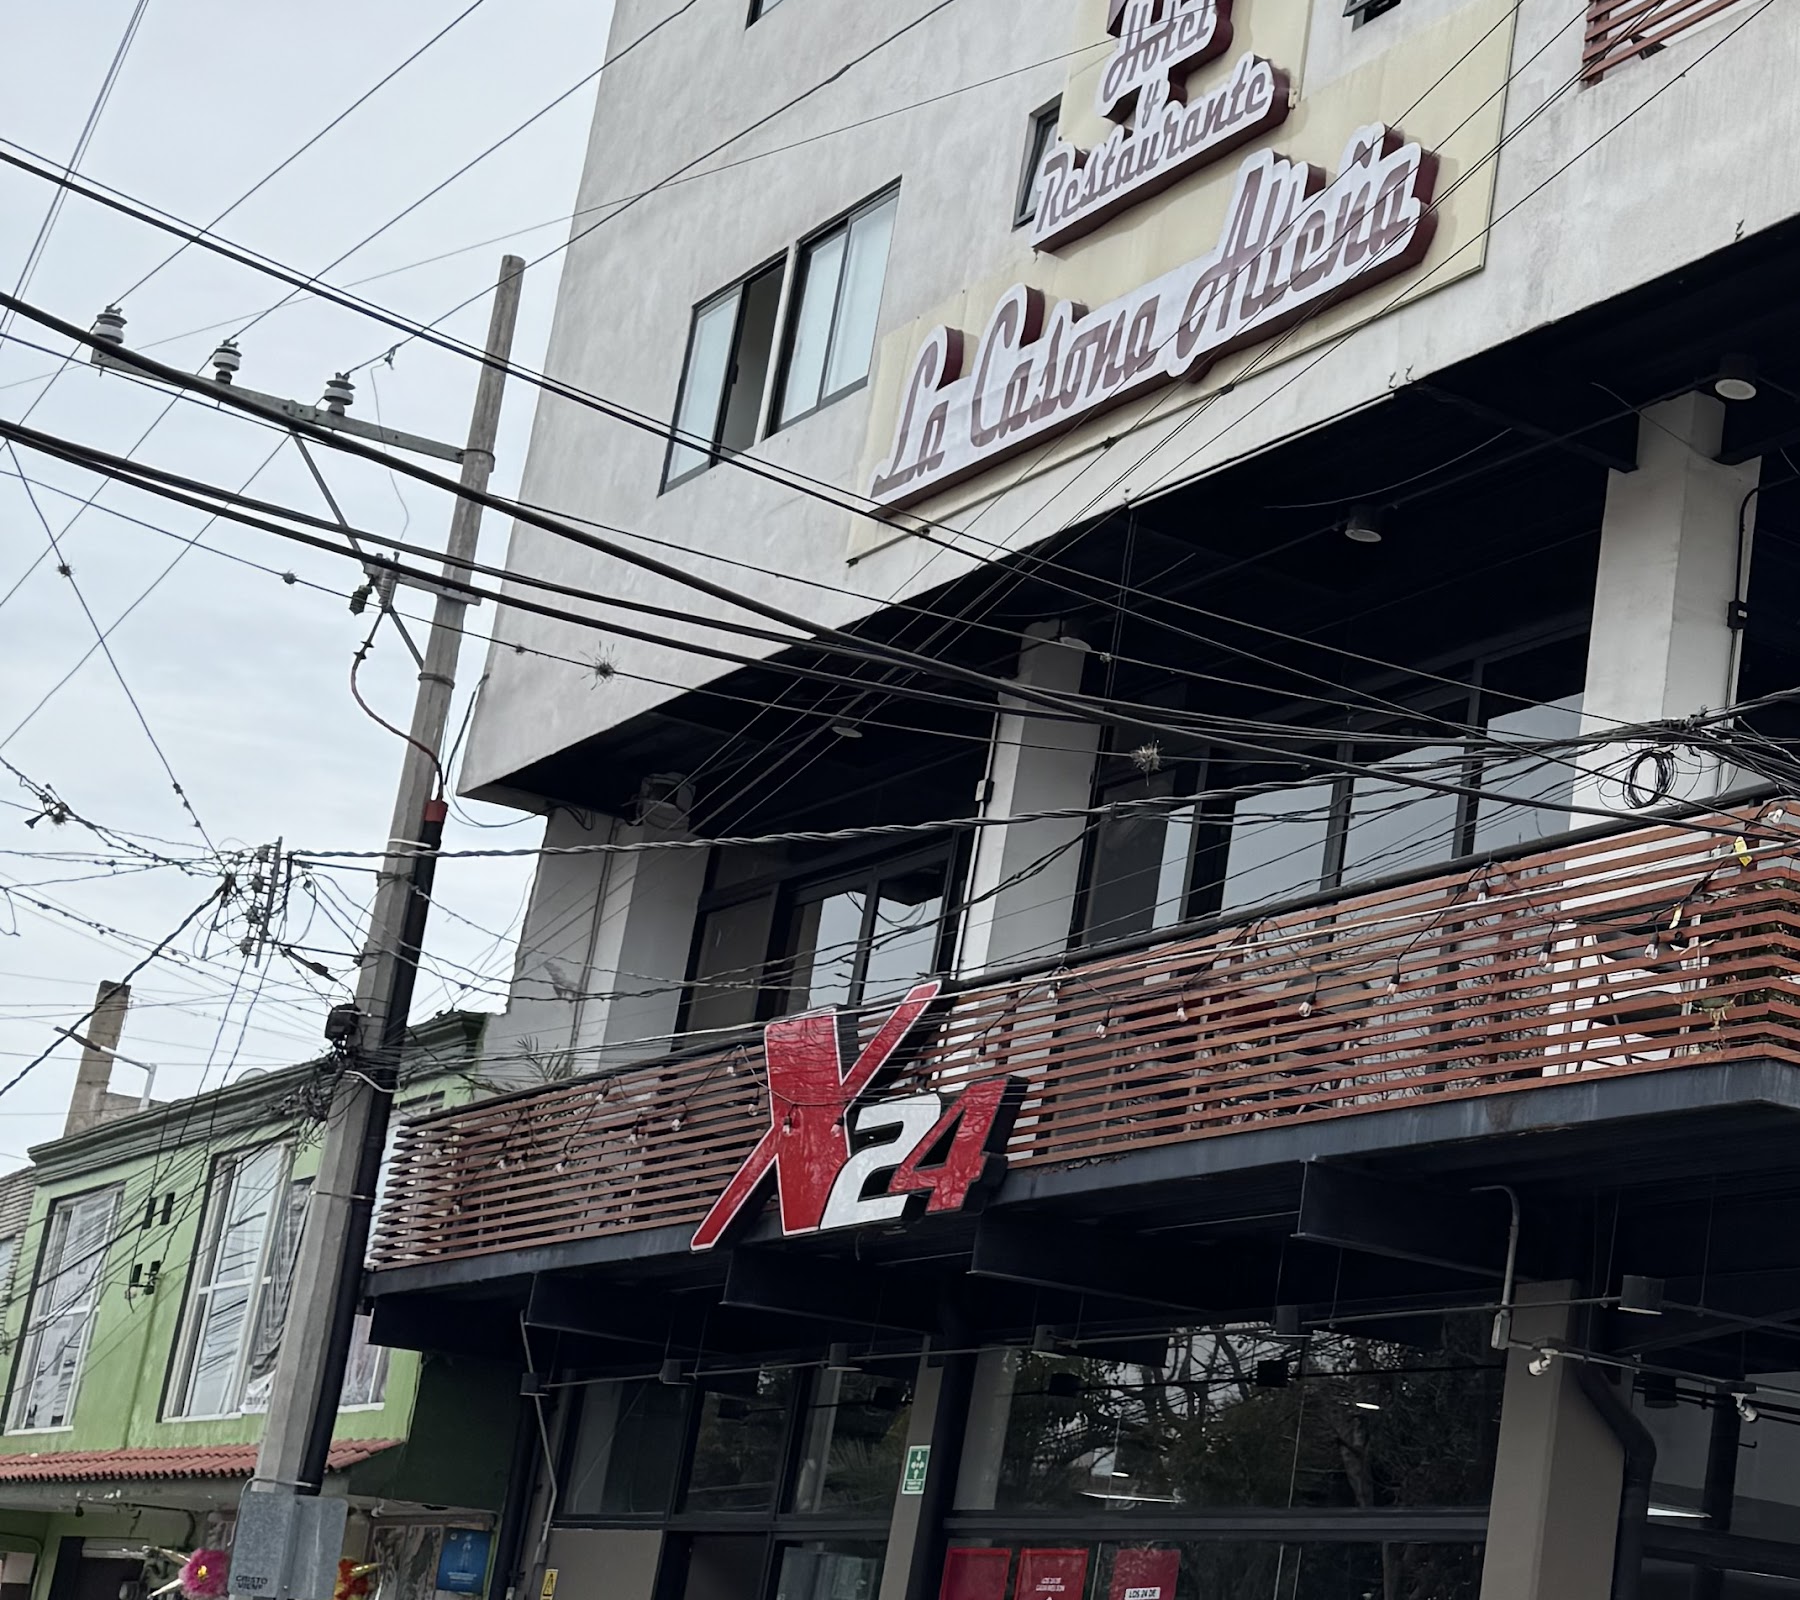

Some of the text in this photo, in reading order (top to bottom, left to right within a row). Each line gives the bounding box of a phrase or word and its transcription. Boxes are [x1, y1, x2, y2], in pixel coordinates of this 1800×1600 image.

[1034, 69, 1268, 235] Restaurante
[1141, 78, 1161, 131] y
[870, 137, 1416, 499] La Casona Alteña
[690, 978, 1008, 1252] X24
